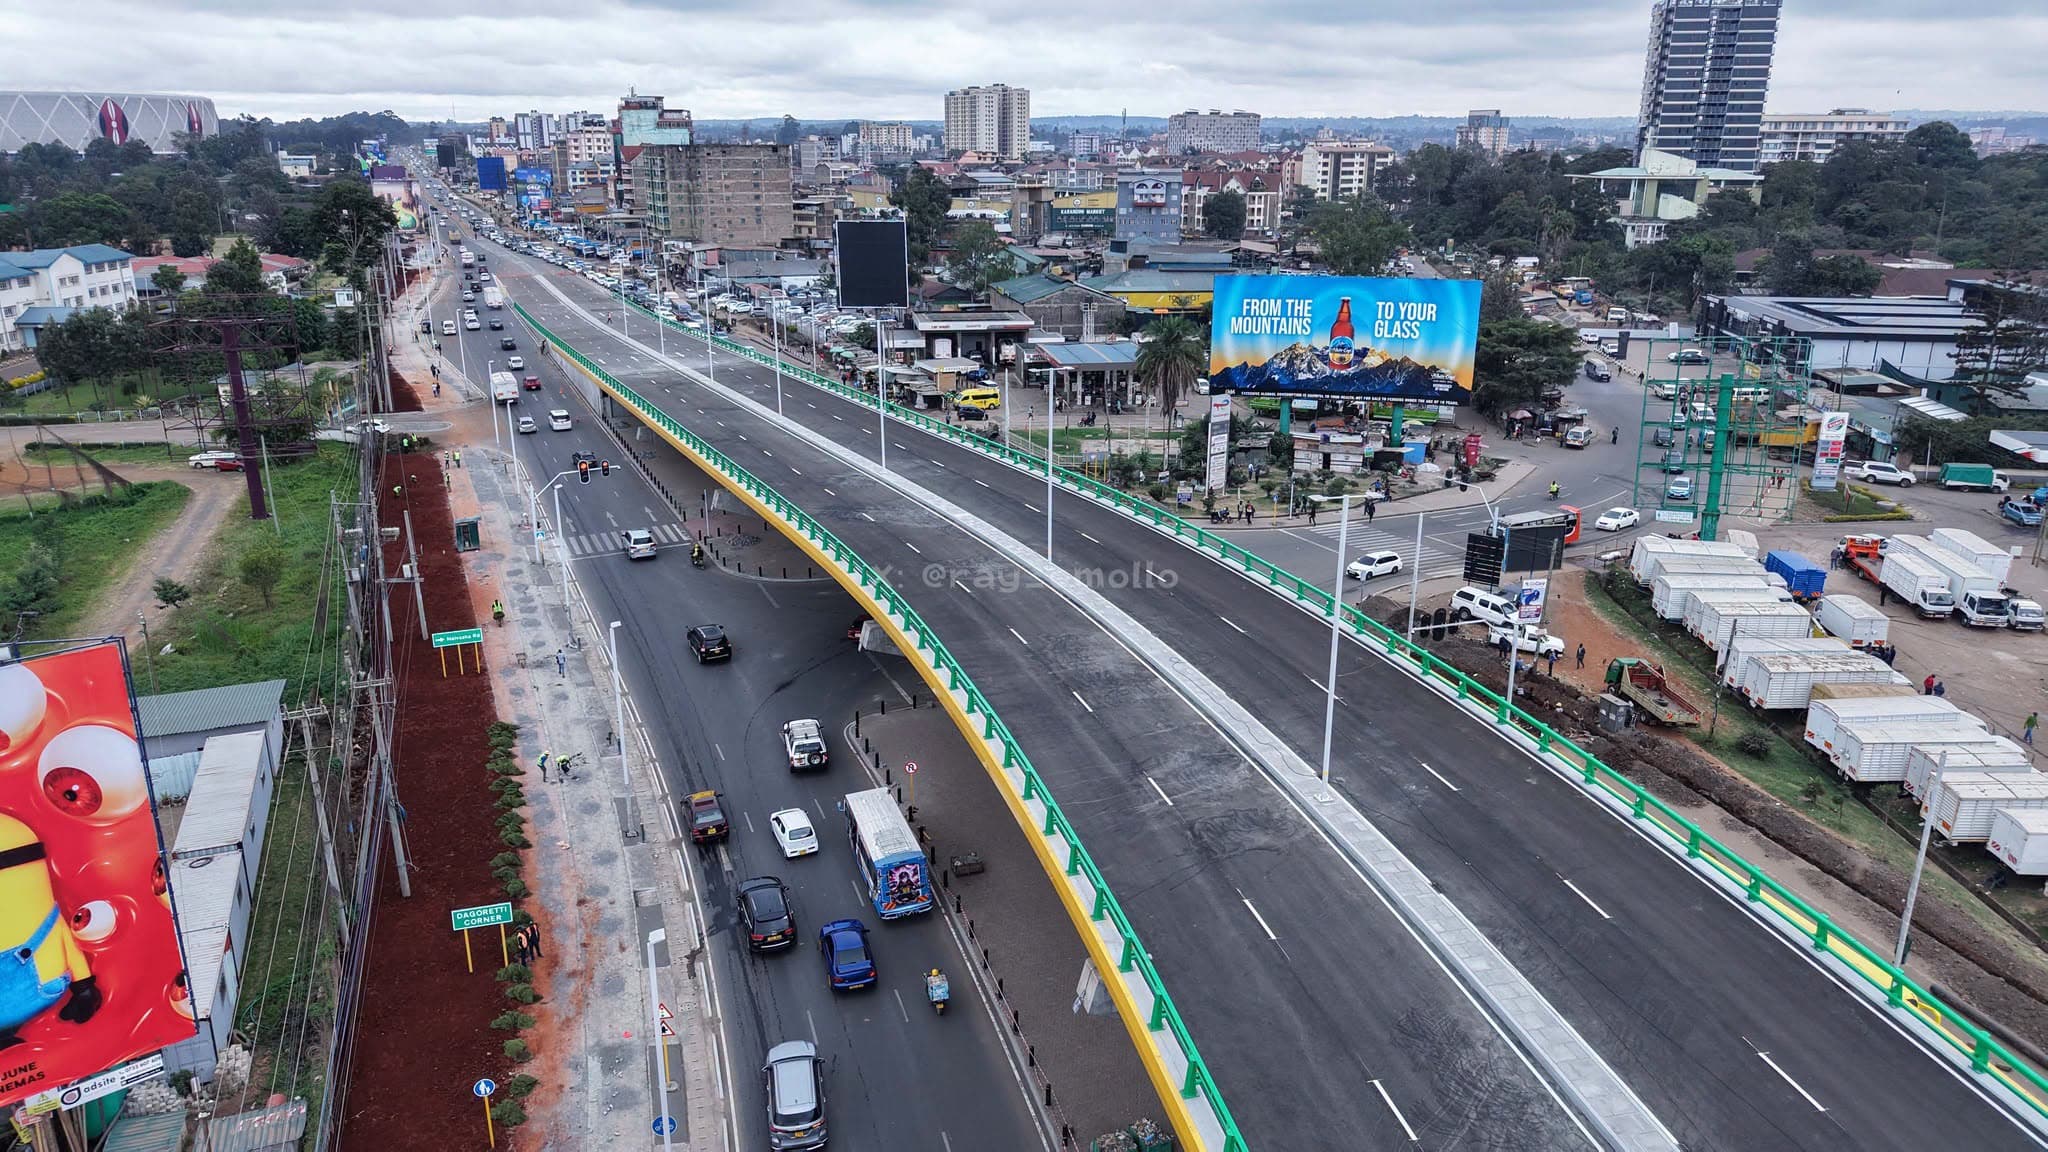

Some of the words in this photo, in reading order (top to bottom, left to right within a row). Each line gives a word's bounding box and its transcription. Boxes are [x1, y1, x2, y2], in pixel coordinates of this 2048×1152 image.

[1242, 298, 1282, 317] FROM
[1285, 299, 1312, 318] THE
[1376, 301, 1394, 320] TO
[1399, 302, 1437, 322] YOUR
[1230, 316, 1312, 335] MOUNTAINS
[1374, 320, 1420, 339] GLASS
[456, 906, 507, 919] DAGORETTI
[464, 915, 502, 926] CORNER
[1, 1062, 37, 1080] JUNE
[83, 1076, 116, 1093] adsite
